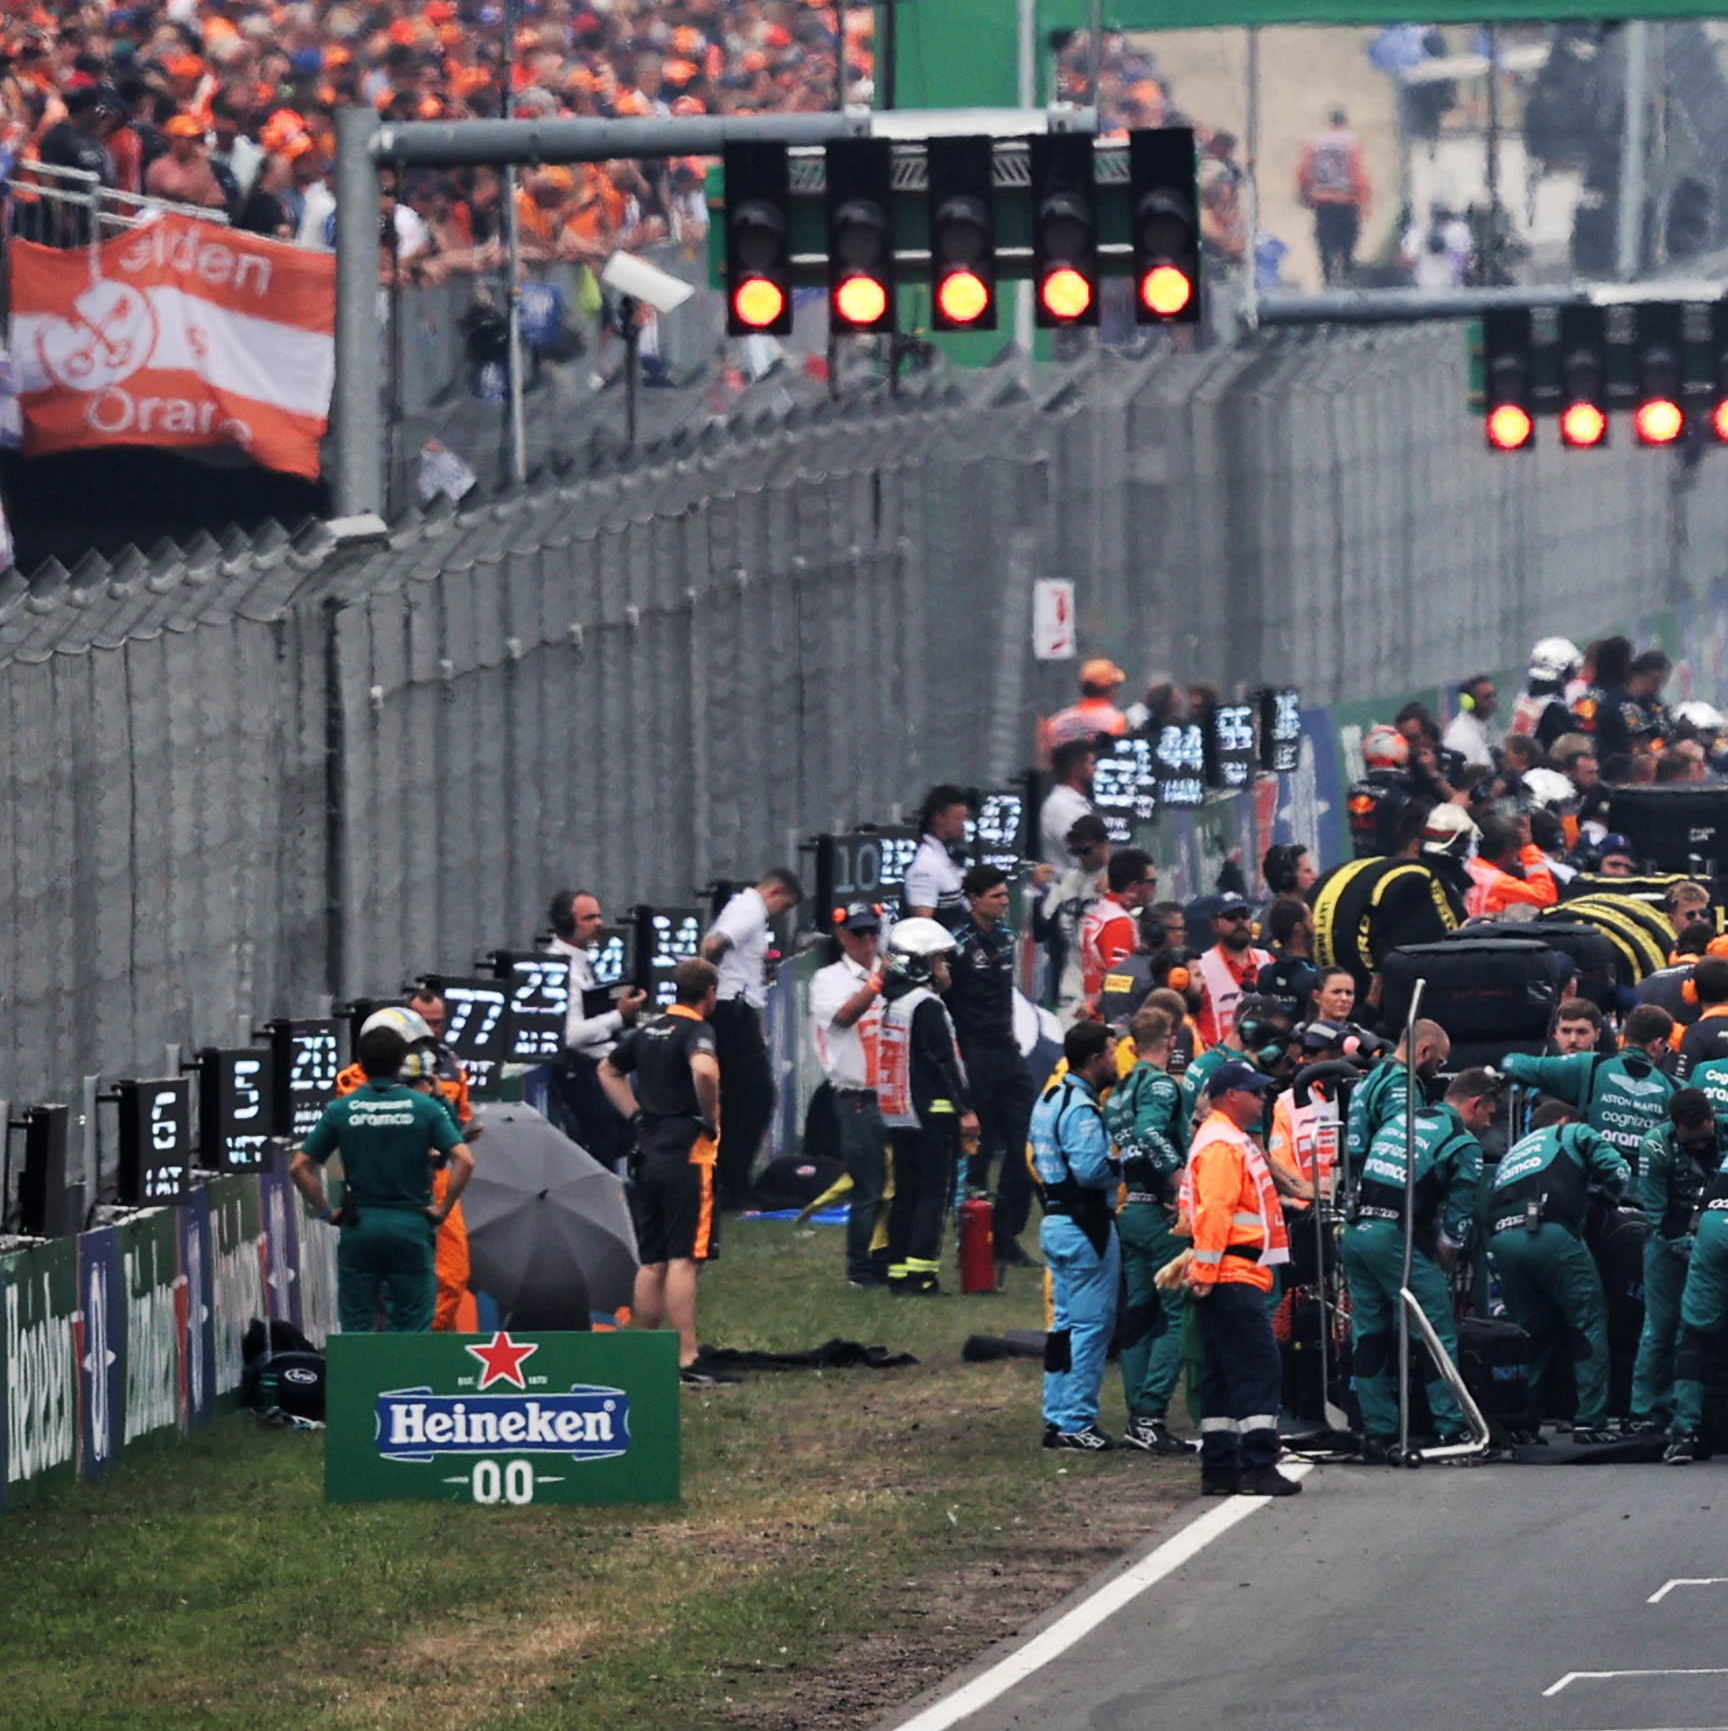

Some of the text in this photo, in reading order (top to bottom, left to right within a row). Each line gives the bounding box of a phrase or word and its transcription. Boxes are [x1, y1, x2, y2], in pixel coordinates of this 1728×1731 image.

[444, 987, 505, 1045] 77
[233, 1060, 261, 1120] 5
[1601, 1093, 1631, 1108] ASTON
[151, 1091, 177, 1150] 6
[348, 1113, 414, 1127] aramco
[1600, 1128, 1641, 1148] aram
[388, 1401, 614, 1444] Heineken
